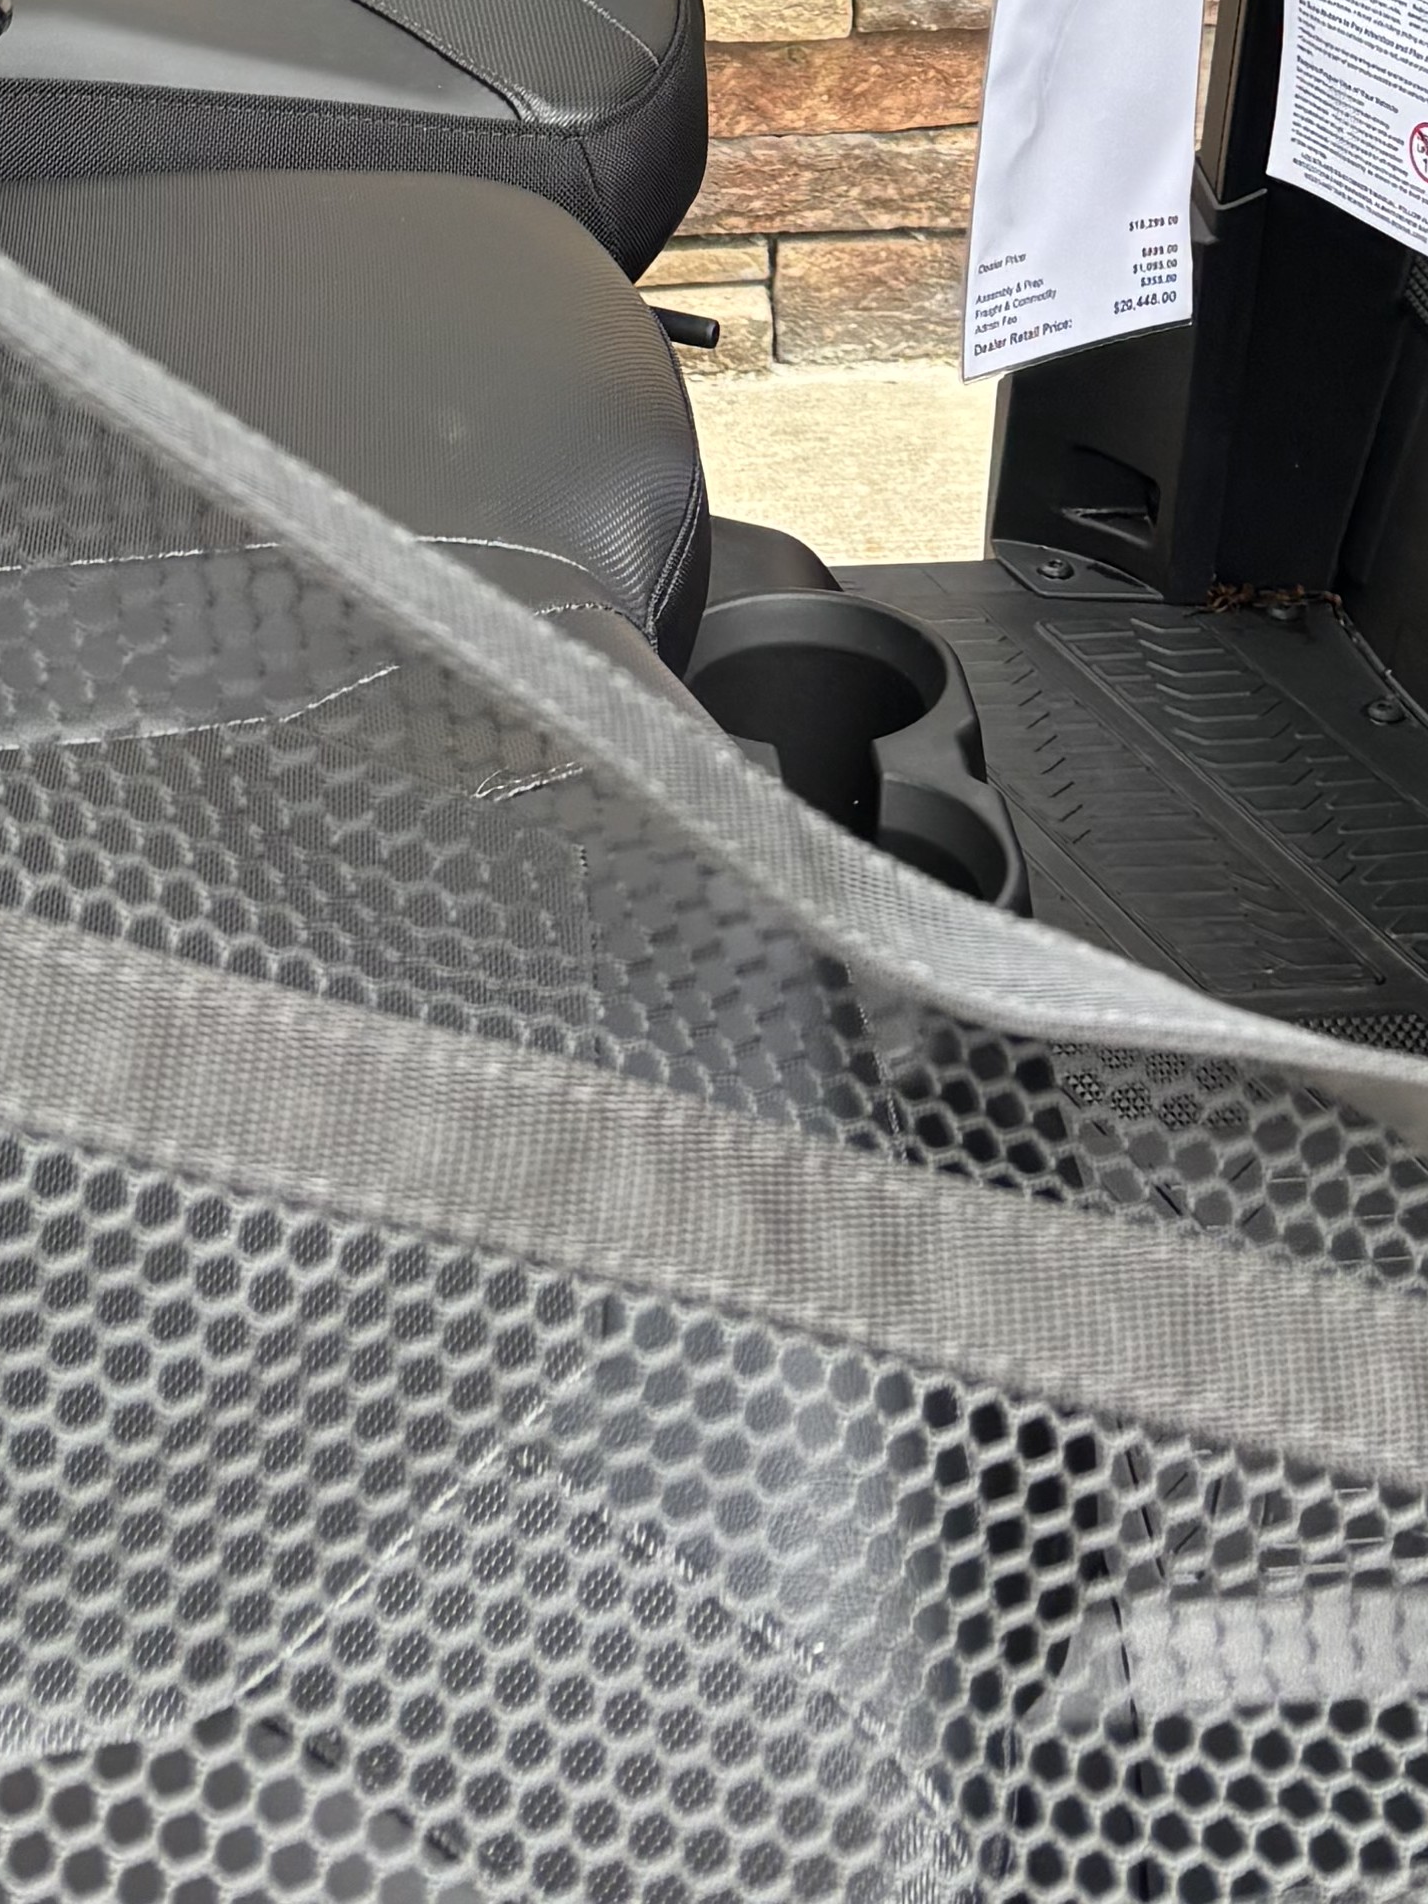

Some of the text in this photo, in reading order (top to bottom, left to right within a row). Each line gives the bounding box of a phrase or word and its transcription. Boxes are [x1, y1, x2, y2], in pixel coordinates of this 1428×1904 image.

[1395, 43, 1409, 54] and
[978, 259, 1003, 275] Dealer
[974, 304, 1003, 320] Freight
[1012, 288, 1057, 310] Commodity
[975, 286, 1013, 305] Assembly
[1113, 290, 1177, 315] $20,448.00
[975, 315, 1018, 335] Admin Fee
[974, 318, 1073, 357] Dealer Retail Price:
